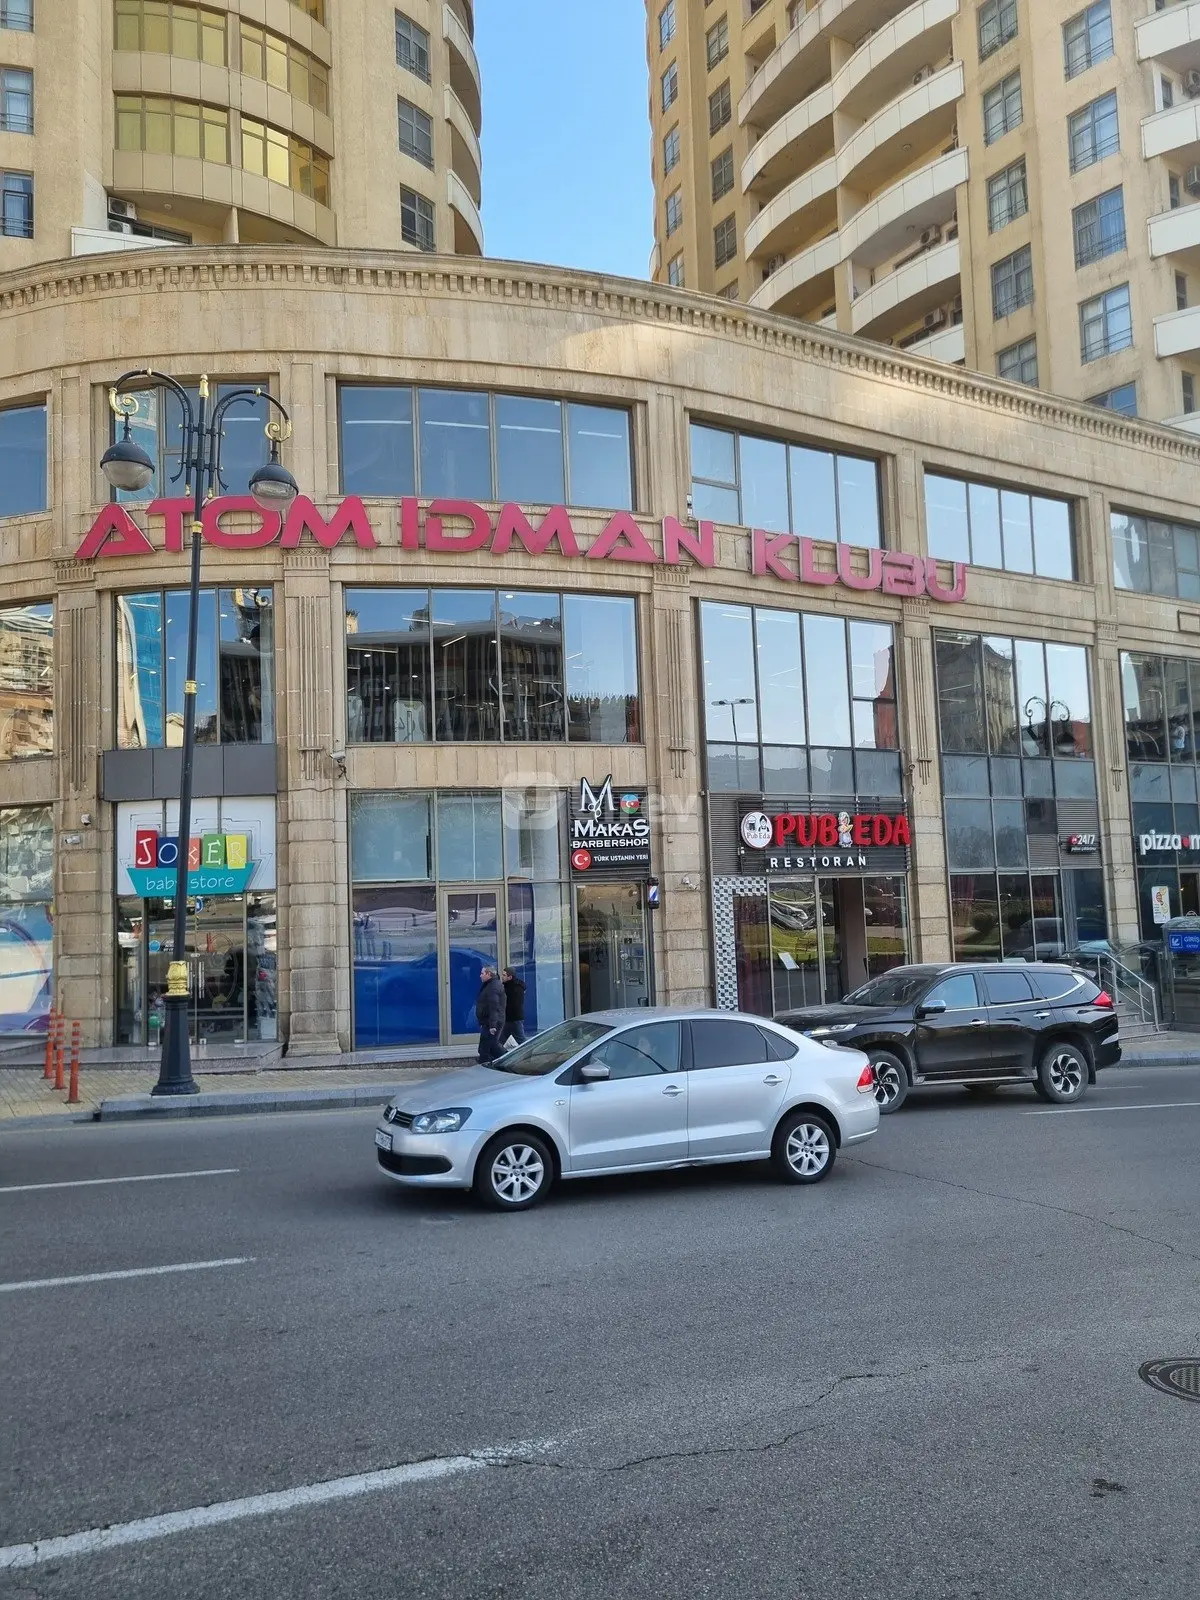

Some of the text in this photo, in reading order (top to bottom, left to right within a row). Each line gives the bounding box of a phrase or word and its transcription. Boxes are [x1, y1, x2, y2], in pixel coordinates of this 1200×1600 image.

[75, 495, 968, 603] ATOM IDMAN KLUBU
[574, 818, 649, 838] MAKAS
[775, 813, 911, 847] PUB EDA
[572, 838, 649, 849] BARBERSHOP
[1077, 834, 1095, 845] 24/7
[1140, 829, 1182, 855] pizza
[770, 856, 867, 868] RESTORAN
[146, 875, 234, 891] bab store
